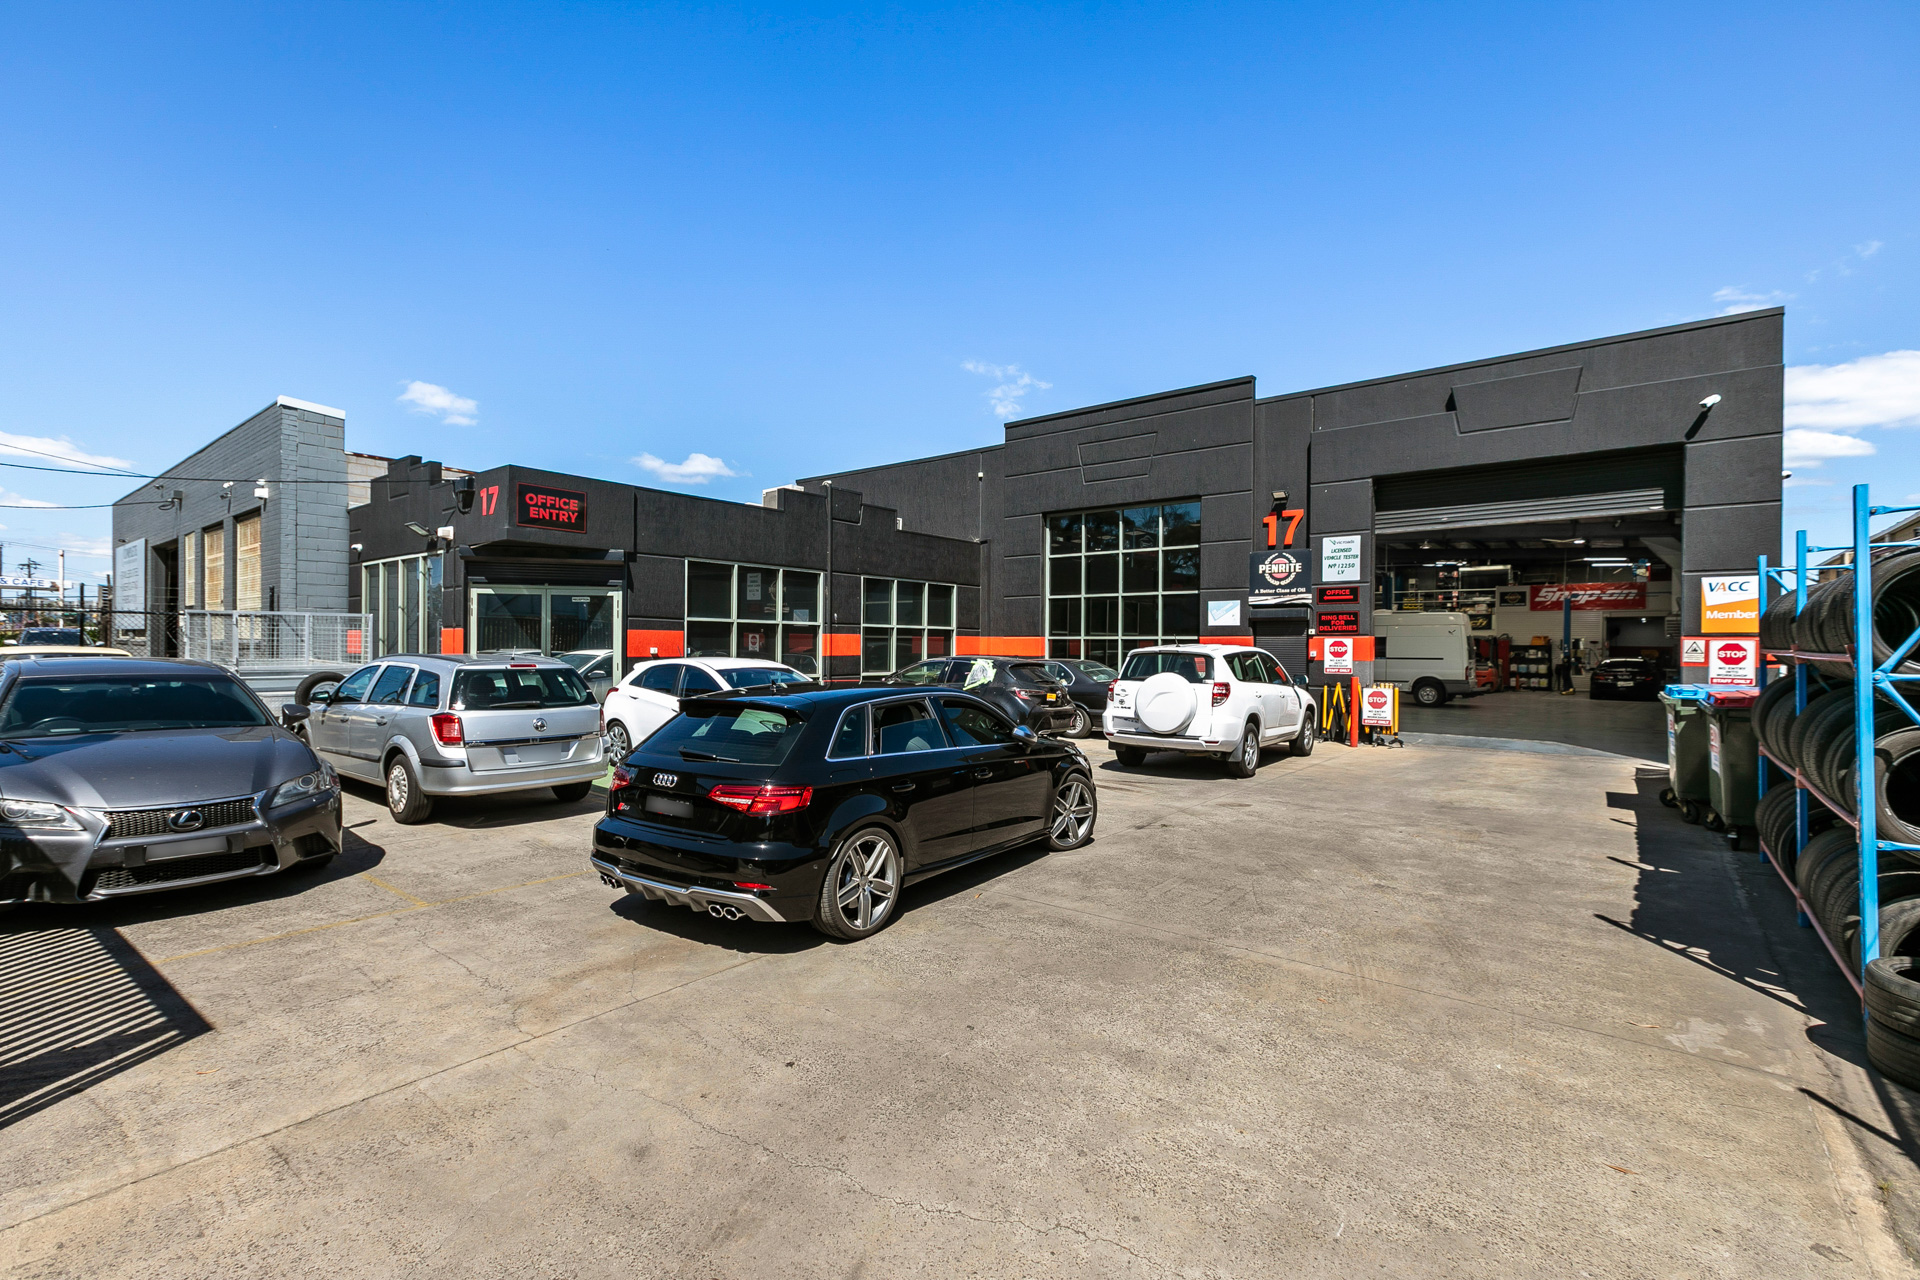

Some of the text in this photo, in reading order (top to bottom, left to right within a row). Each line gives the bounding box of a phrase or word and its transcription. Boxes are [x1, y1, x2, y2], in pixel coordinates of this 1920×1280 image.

[480, 486, 499, 516] 17
[525, 493, 579, 511] OFFICE
[529, 507, 578, 523] ENTRY
[1263, 509, 1304, 546] 17
[1259, 563, 1302, 574] PENRITE
[12, 578, 45, 586] CAFE
[1708, 581, 1750, 592] VACC
[1706, 610, 1758, 619] Member
[1718, 650, 1747, 658] STOP
